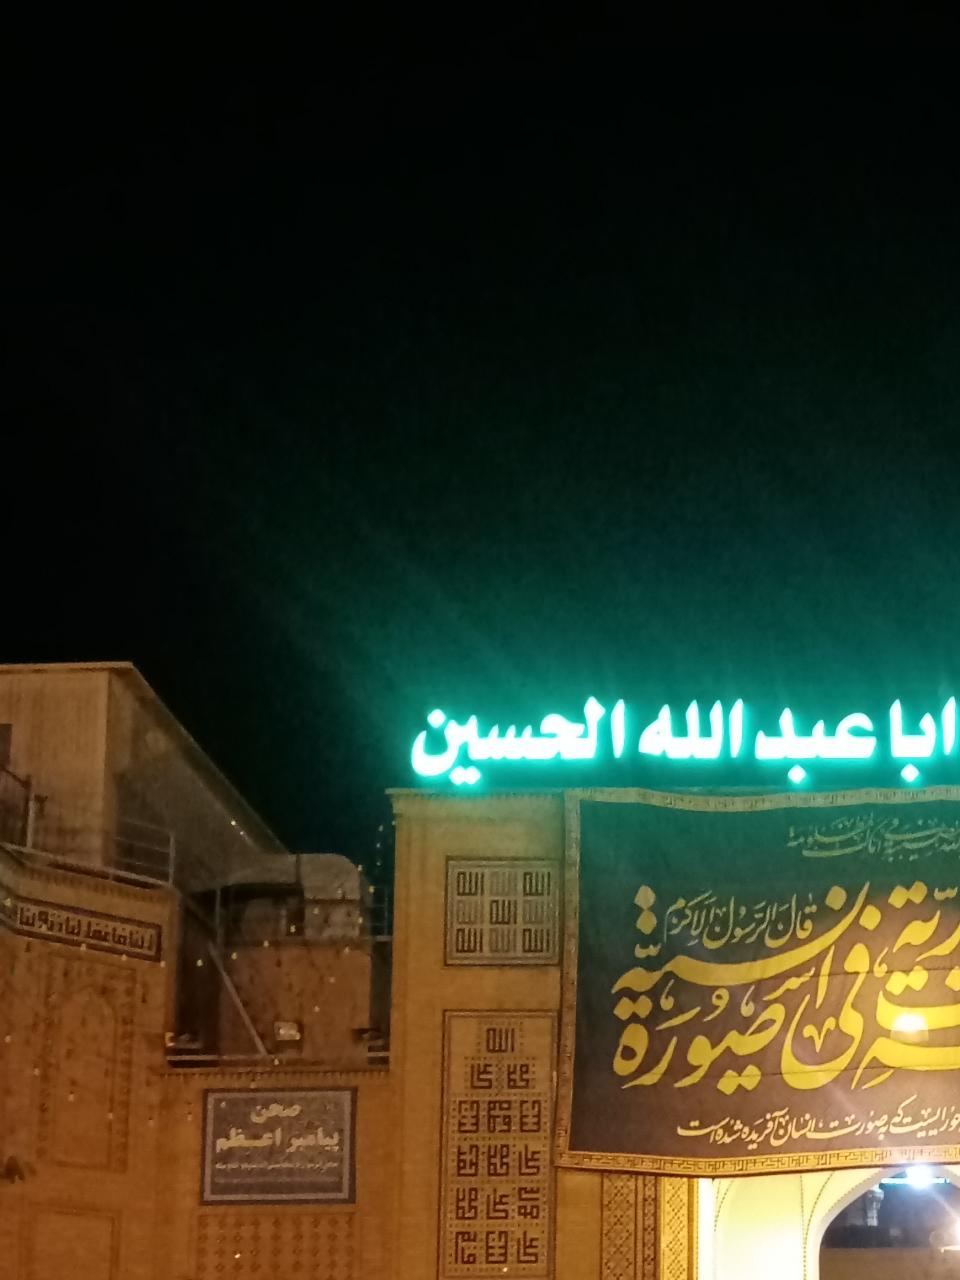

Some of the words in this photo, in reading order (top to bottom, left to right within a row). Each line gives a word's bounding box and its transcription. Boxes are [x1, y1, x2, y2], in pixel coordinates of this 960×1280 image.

[411, 696, 626, 785] الحسين
[457, 872, 485, 896] الله
[523, 872, 551, 896] الله
[490, 899, 517, 925] الله
[456, 928, 484, 953] الله
[522, 928, 550, 953] الله
[486, 1027, 515, 1053] الله
